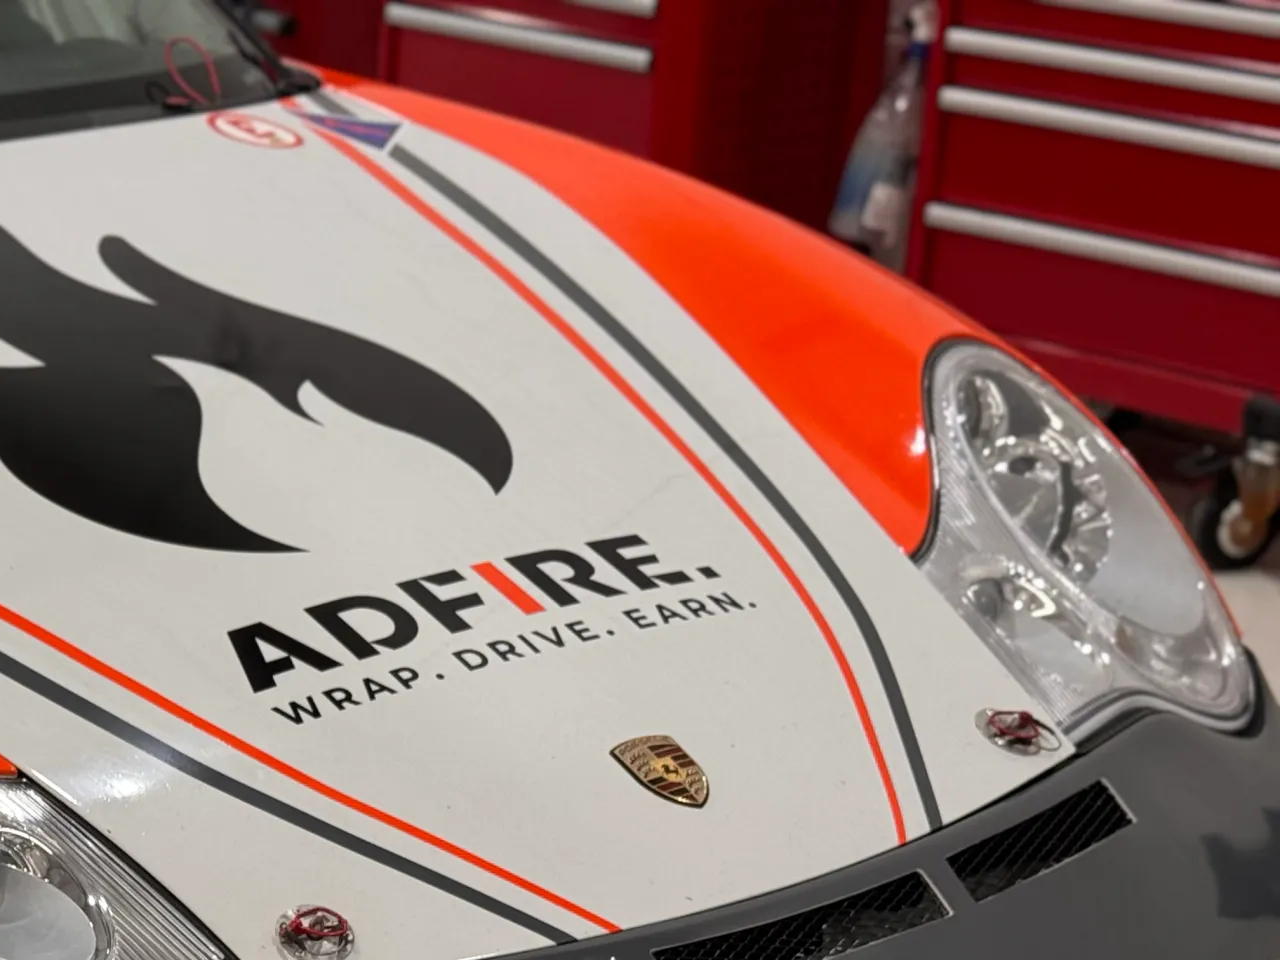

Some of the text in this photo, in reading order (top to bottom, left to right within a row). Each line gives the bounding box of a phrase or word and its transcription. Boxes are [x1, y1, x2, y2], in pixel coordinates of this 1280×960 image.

[226, 533, 721, 694] ADFIRE.
[451, 619, 616, 673] DRIVE.
[624, 591, 757, 631] EARN.
